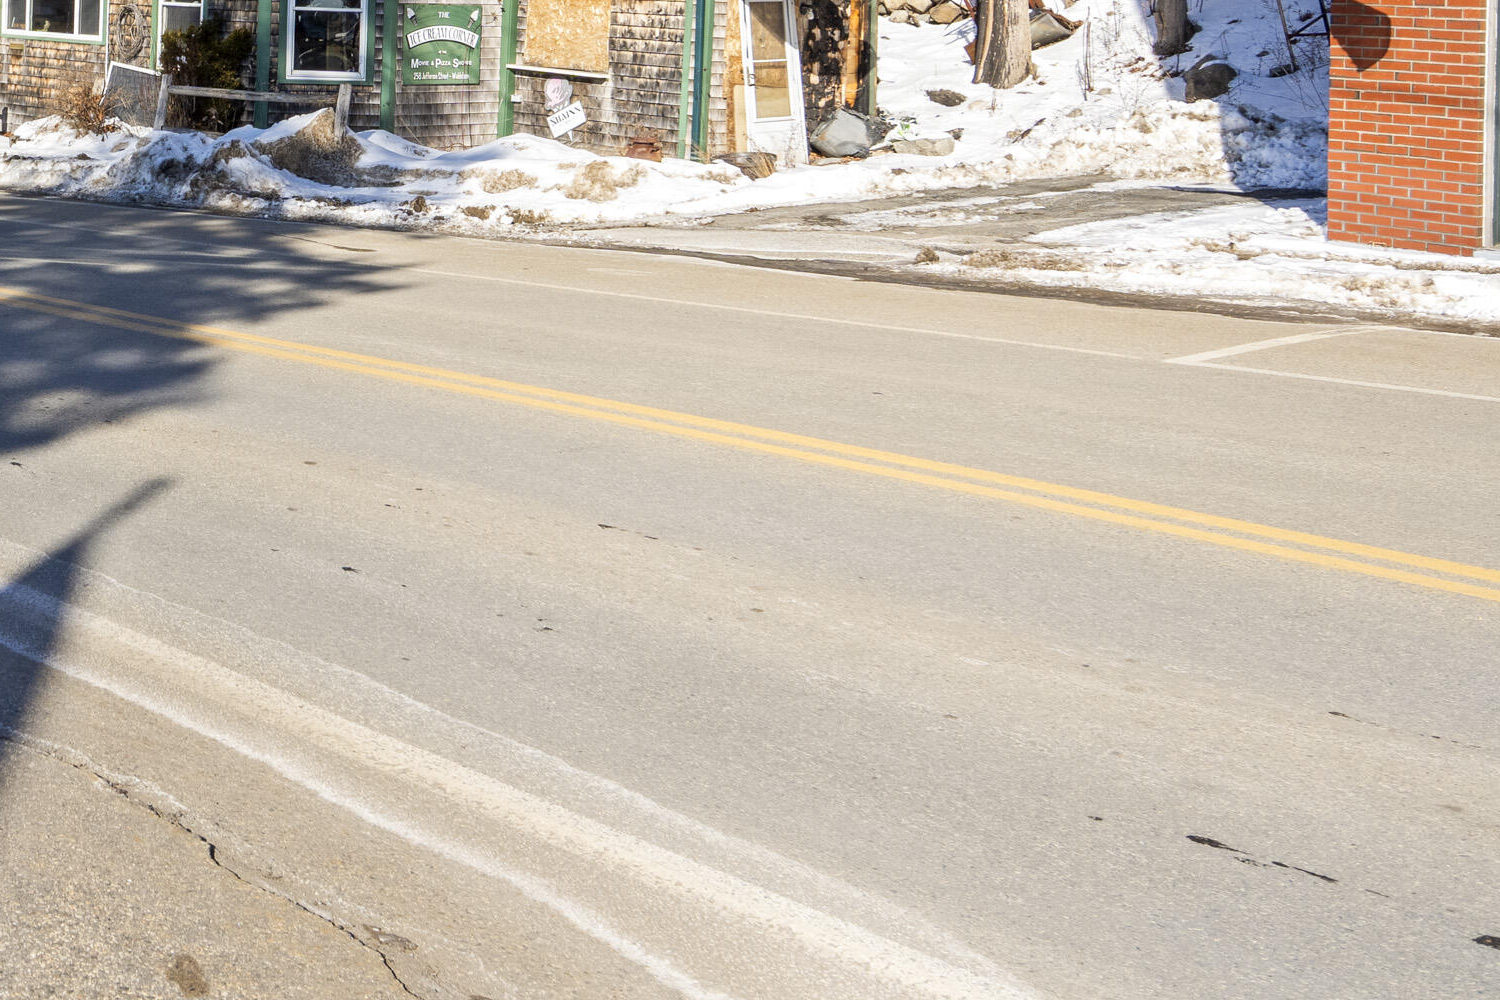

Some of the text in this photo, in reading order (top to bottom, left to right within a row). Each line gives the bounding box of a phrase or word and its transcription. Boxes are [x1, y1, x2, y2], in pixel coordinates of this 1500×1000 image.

[437, 11, 450, 19] THE
[409, 27, 476, 46] ICE CREAM CORNER
[435, 58, 452, 69] PIZZA
